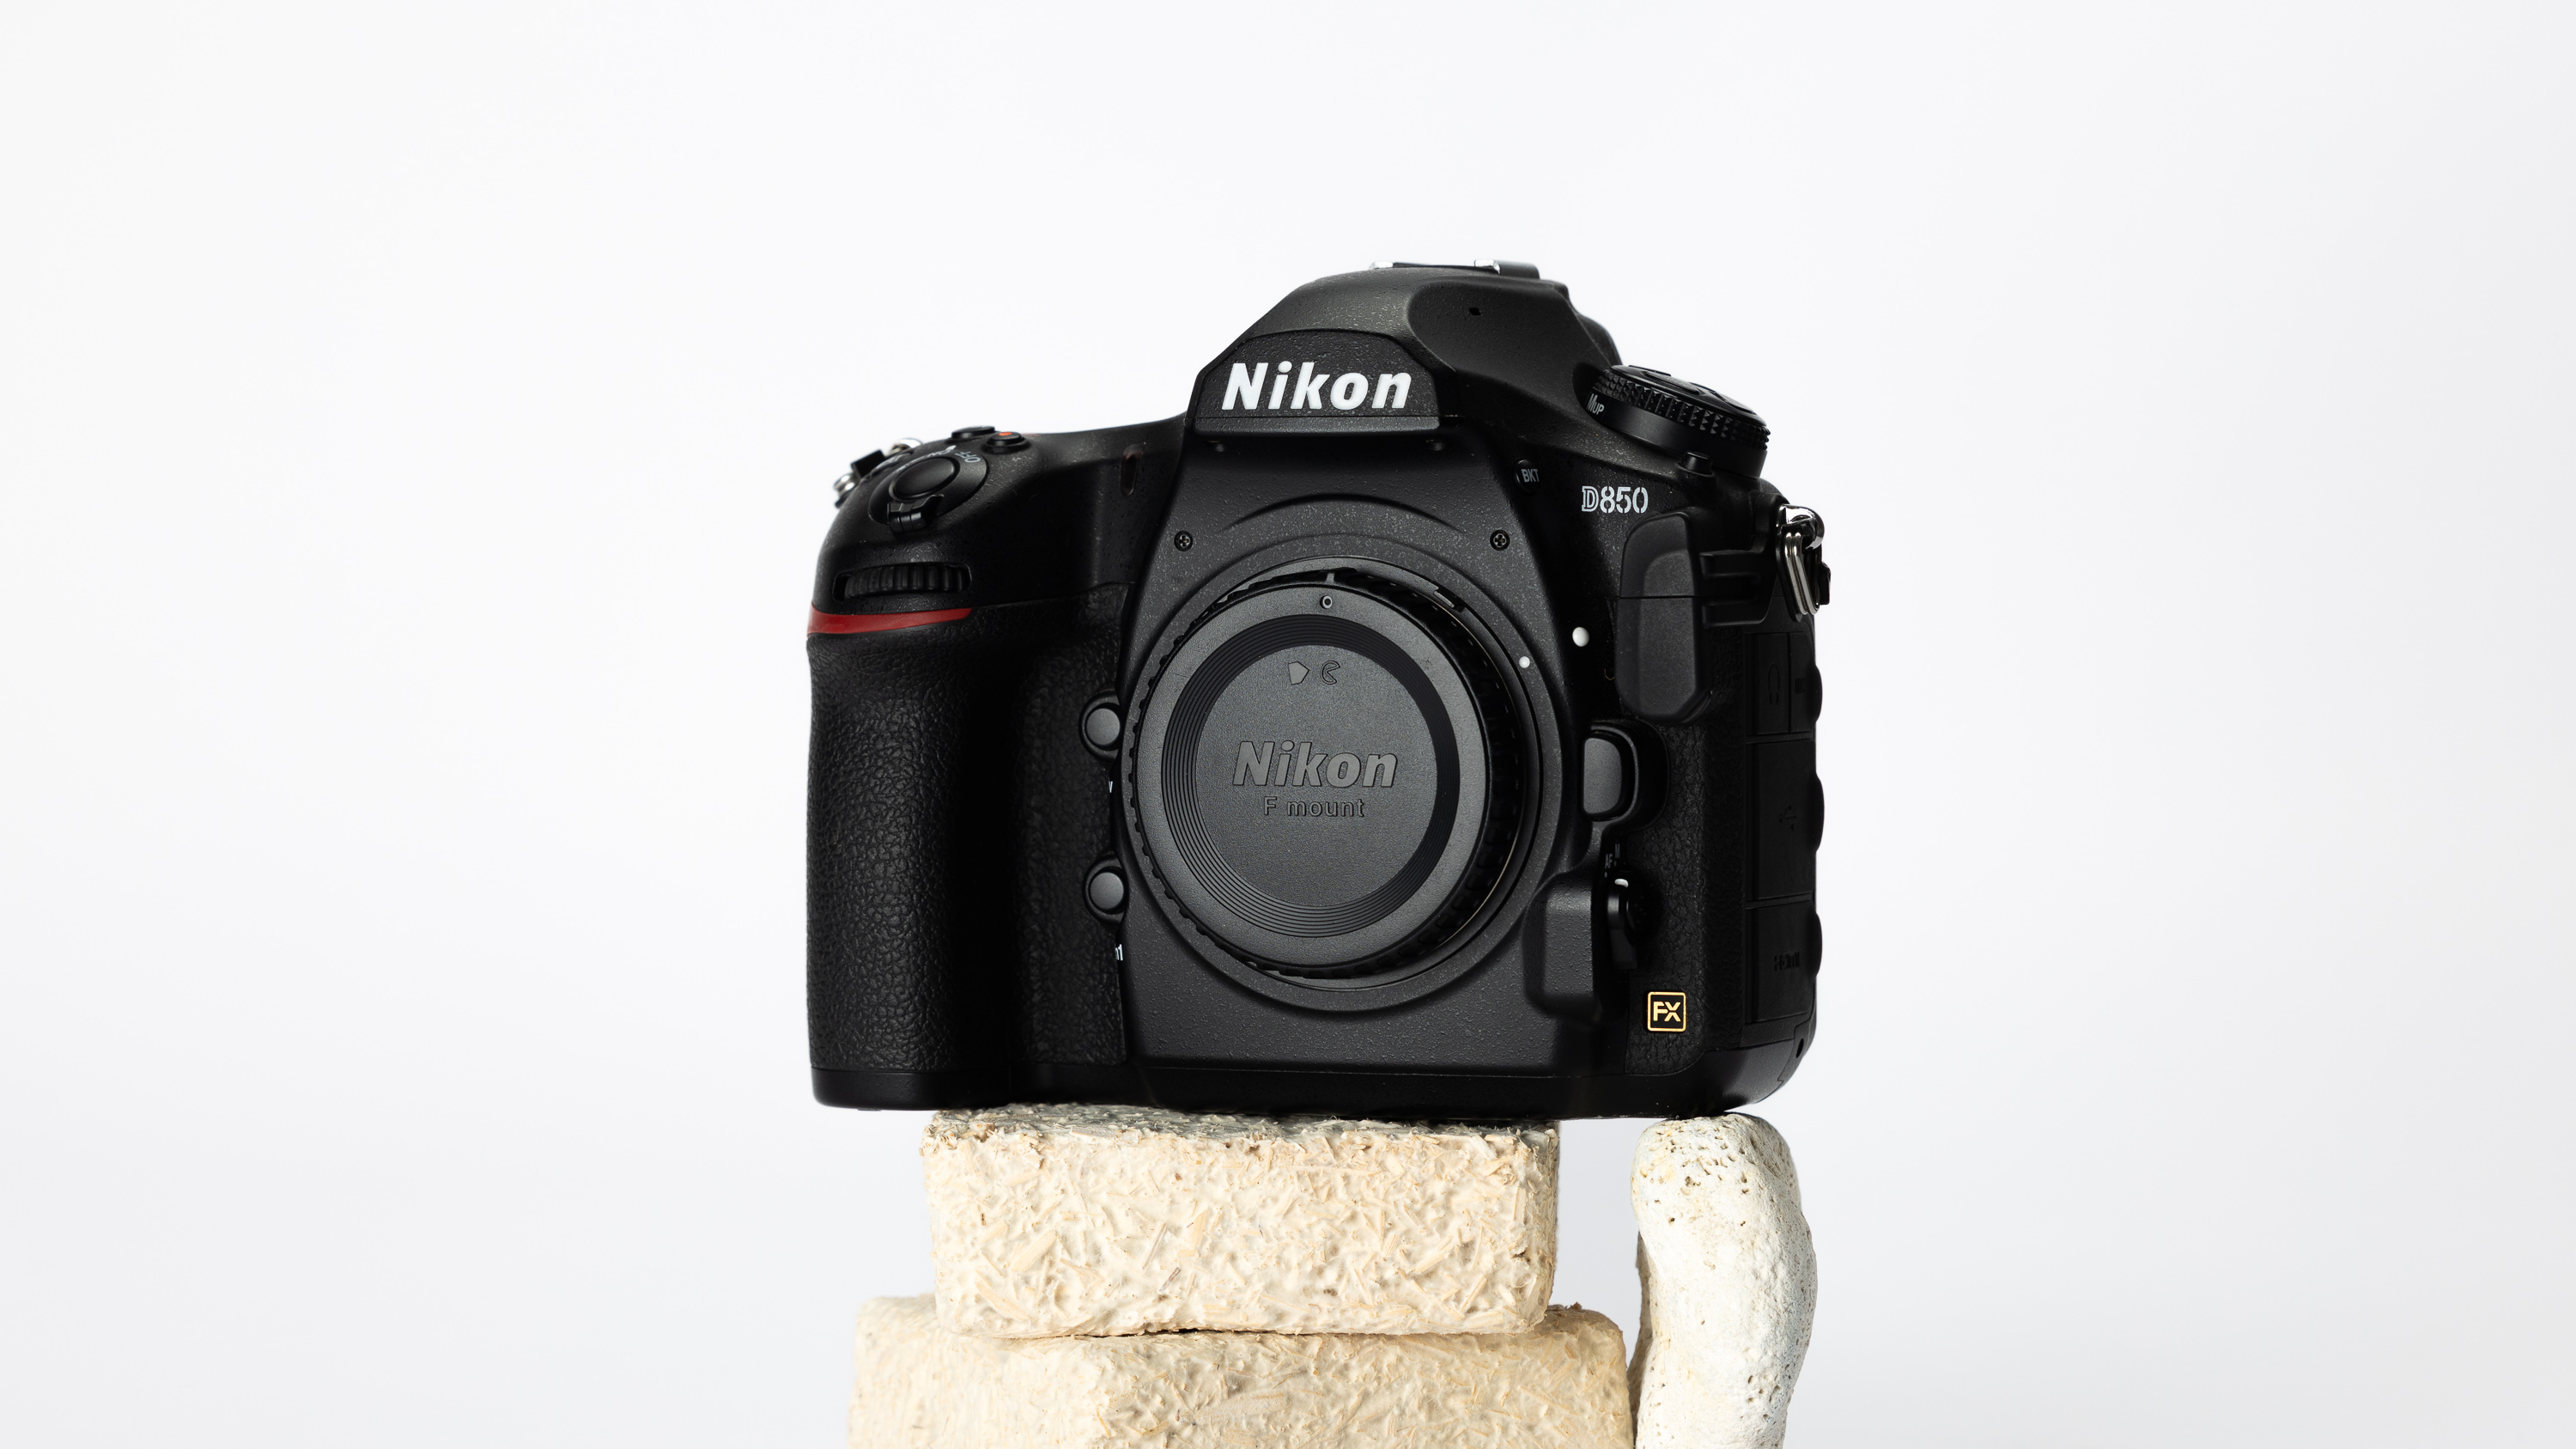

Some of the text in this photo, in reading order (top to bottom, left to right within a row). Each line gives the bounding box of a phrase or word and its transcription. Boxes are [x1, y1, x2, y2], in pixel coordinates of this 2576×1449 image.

[1221, 360, 1412, 411] Nikon
[1521, 468, 1540, 483] BKT
[1581, 485, 1649, 514] D850
[1232, 740, 1398, 788] Nikon
[1263, 795, 1365, 818] F mount
[1604, 853, 1613, 869] AF
[1653, 1001, 1682, 1022] FX
